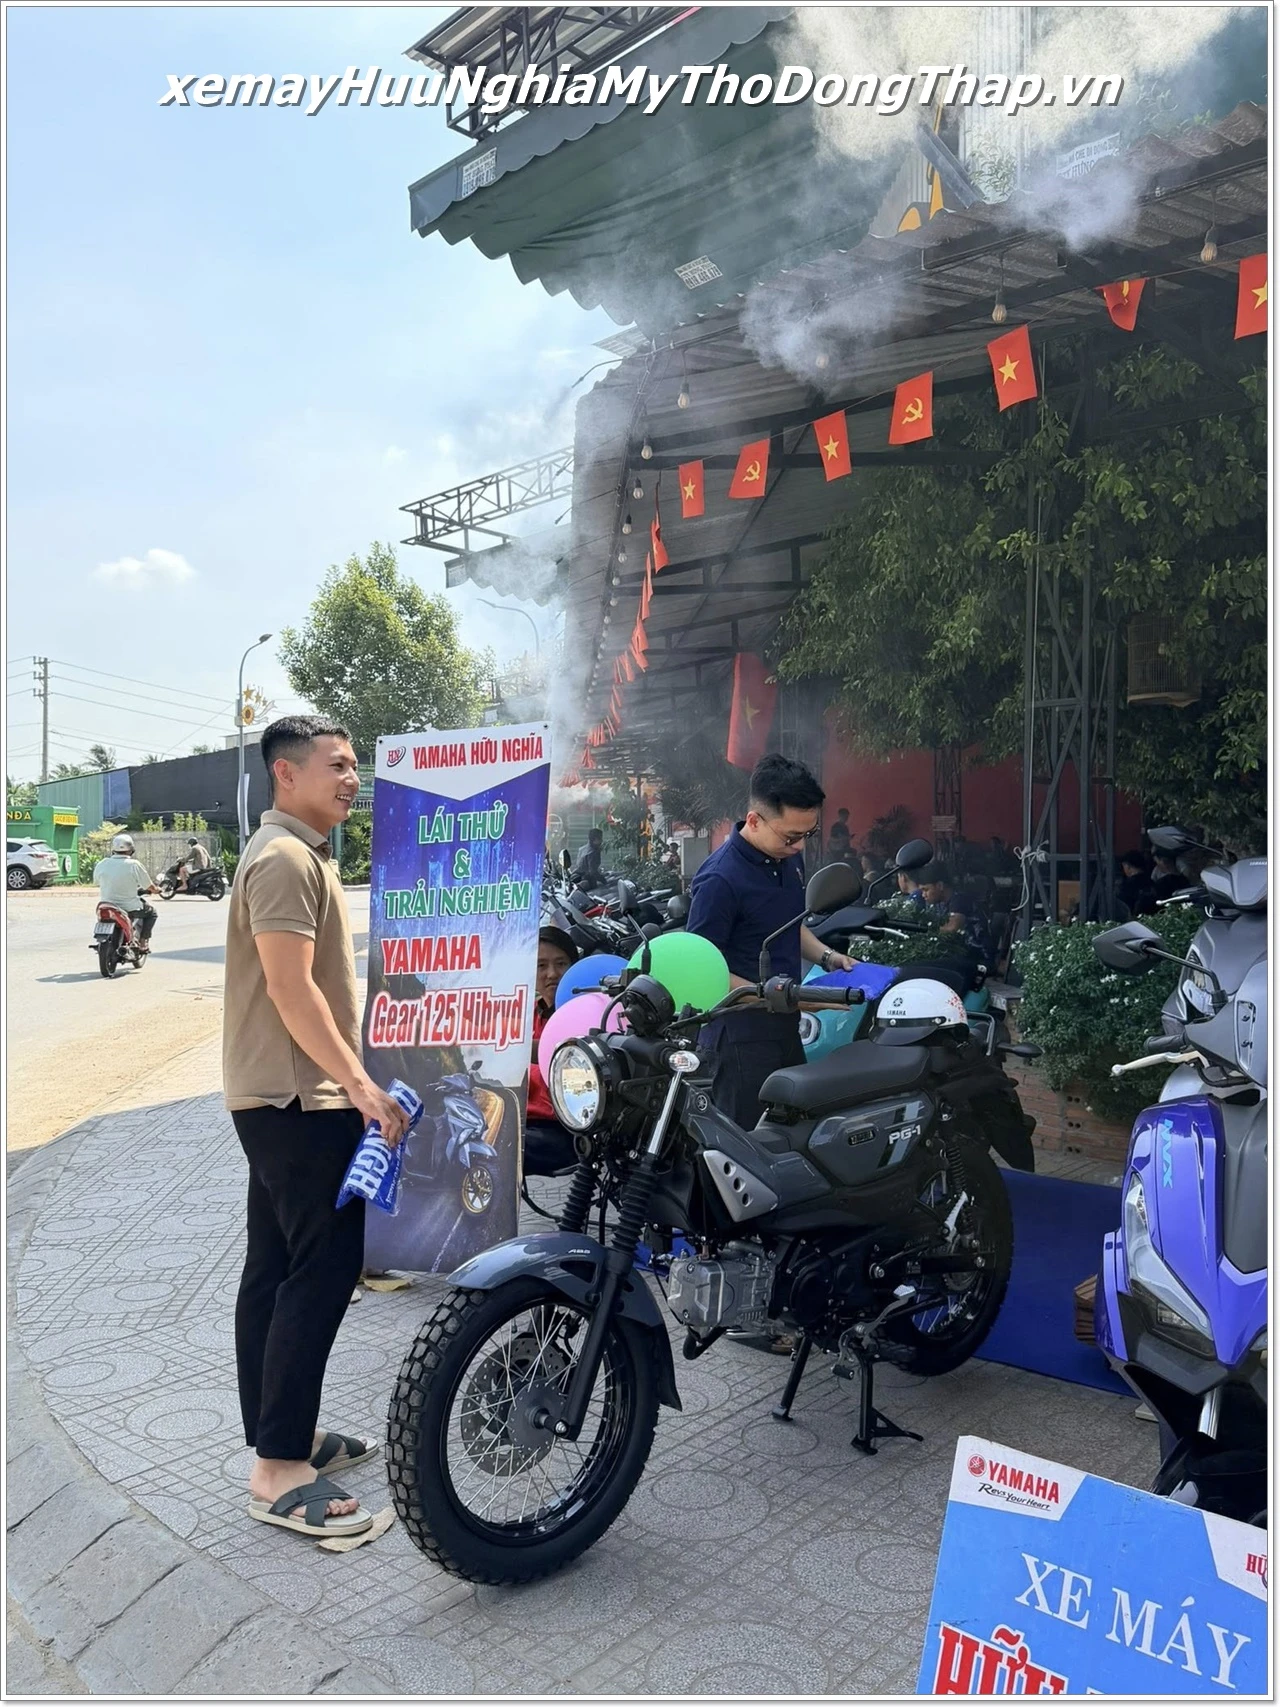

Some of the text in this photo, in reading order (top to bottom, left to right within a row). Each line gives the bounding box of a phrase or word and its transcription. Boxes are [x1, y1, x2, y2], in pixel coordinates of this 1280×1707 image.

[413, 732, 543, 770] YAMAHA HỮU NGHĨA
[418, 800, 508, 844] LÁI THỬ
[453, 848, 471, 879] &
[385, 874, 531, 920] TRẢI NGHIỆM
[381, 935, 482, 974] YAMAHA
[369, 985, 528, 1052] Gear 125 Hibryd
[888, 1124, 922, 1145] PG-1
[1160, 1117, 1174, 1190] NVX
[988, 1459, 1059, 1504] YAMAHA
[1015, 1552, 1252, 1689] XE MÁY
